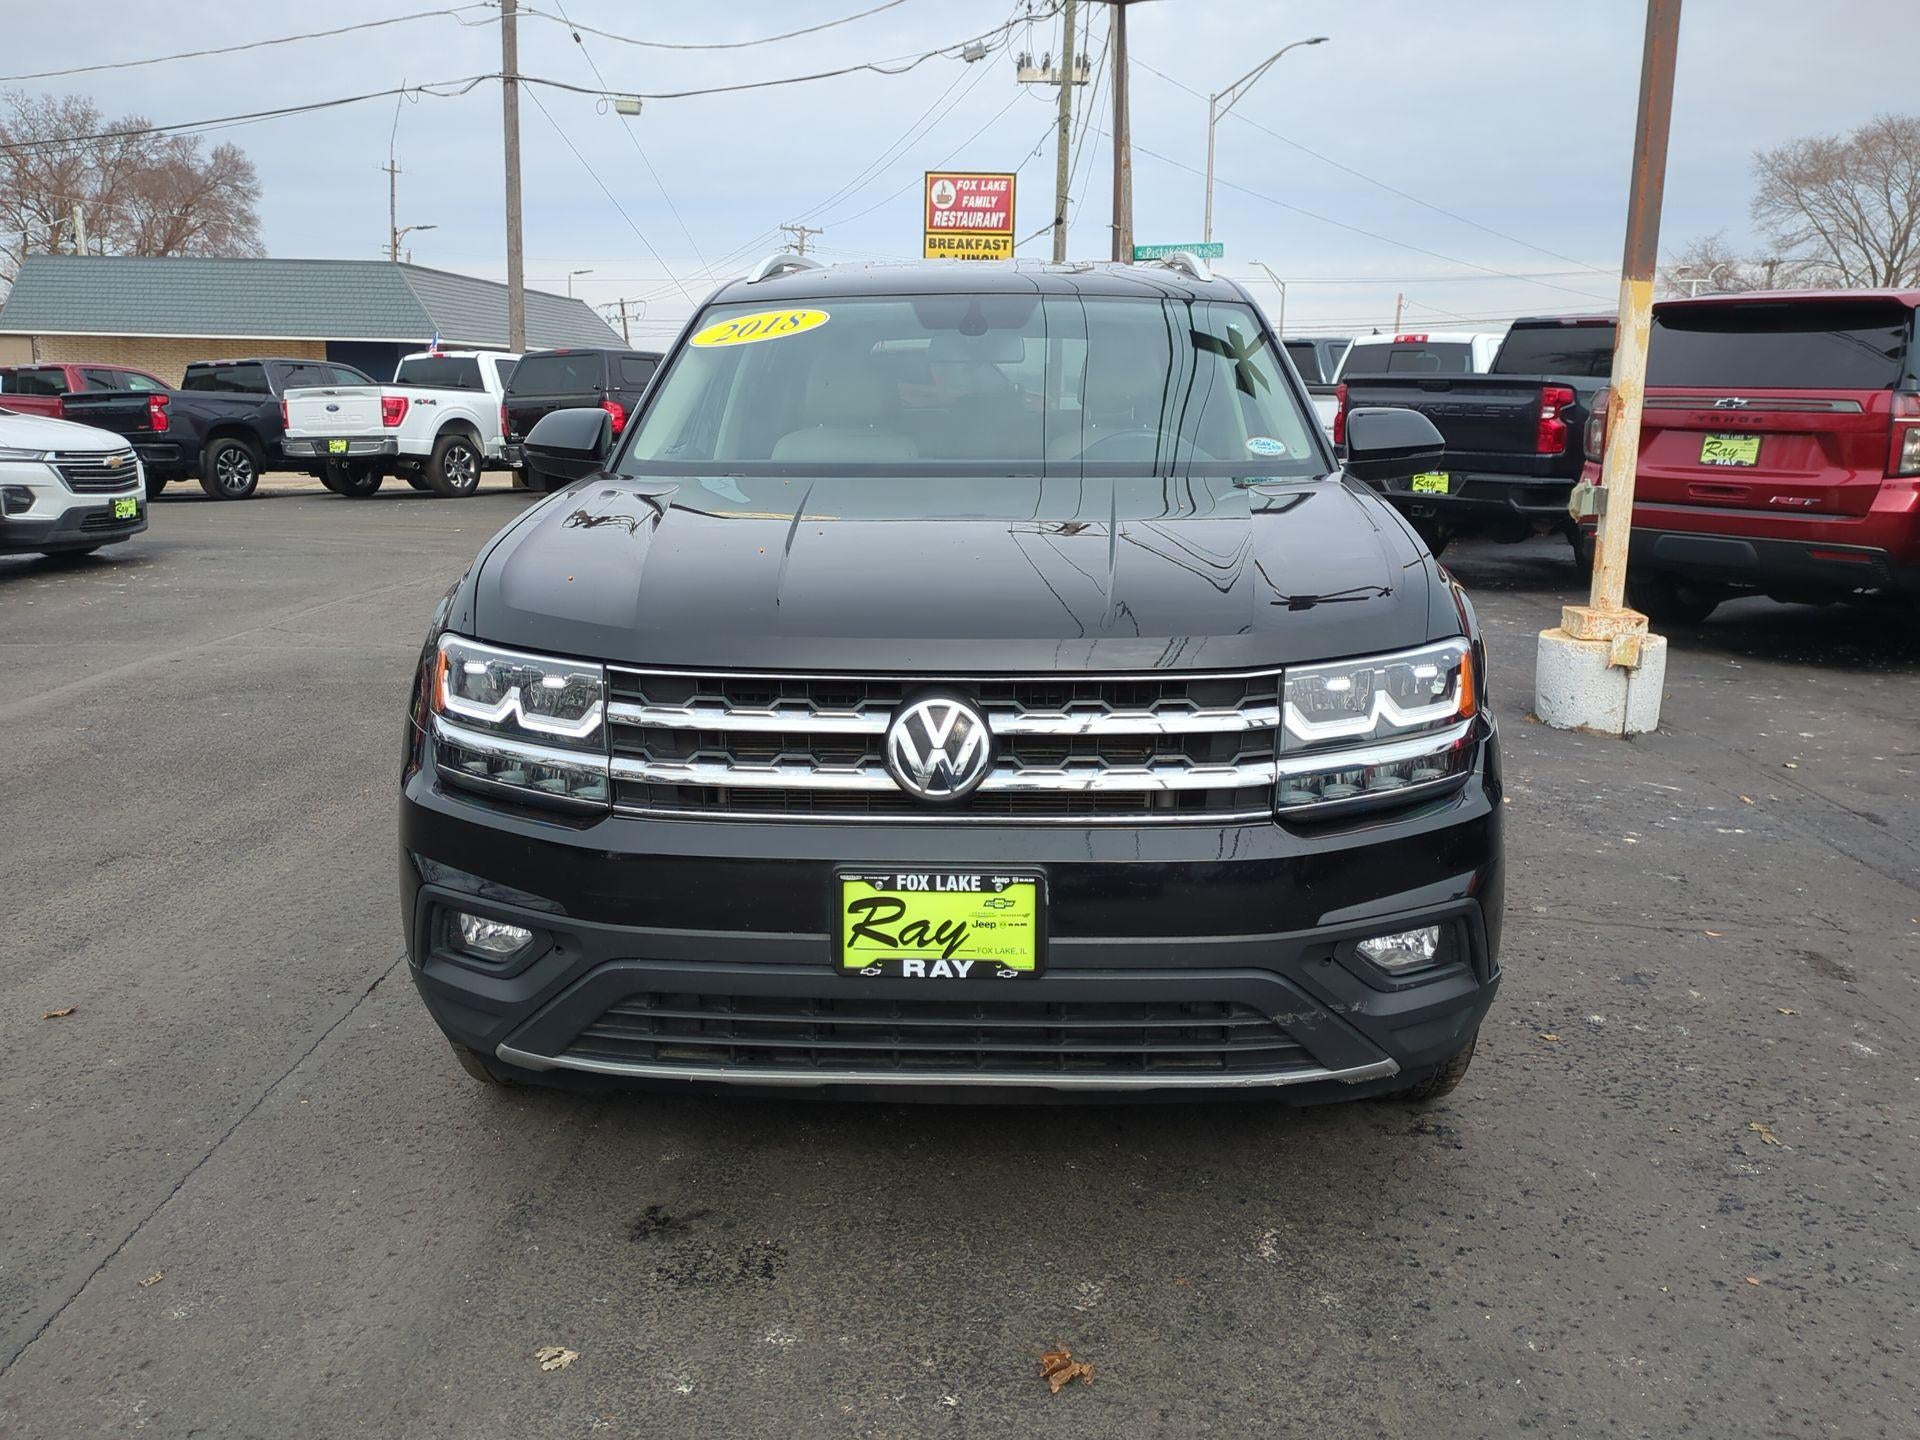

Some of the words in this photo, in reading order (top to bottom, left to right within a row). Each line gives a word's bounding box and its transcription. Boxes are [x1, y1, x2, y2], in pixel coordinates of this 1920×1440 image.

[956, 180, 978, 191] FOX
[980, 180, 1008, 192] LAKE
[961, 195, 998, 208] FAMILY
[933, 210, 1006, 228] RESTAURANT
[928, 238, 1010, 250] BREAKFAST
[713, 312, 806, 343] 2018
[1697, 414, 1764, 424] TAHOE
[1703, 440, 1739, 461] Ray
[1414, 475, 1437, 490] Ray
[896, 874, 930, 891] FOX
[936, 875, 982, 892] LAKE
[991, 875, 1010, 884] Jeep
[847, 896, 970, 960] Ray
[971, 919, 997, 930] Jeep
[976, 946, 993, 955] FOX
[902, 959, 975, 979] RAY
